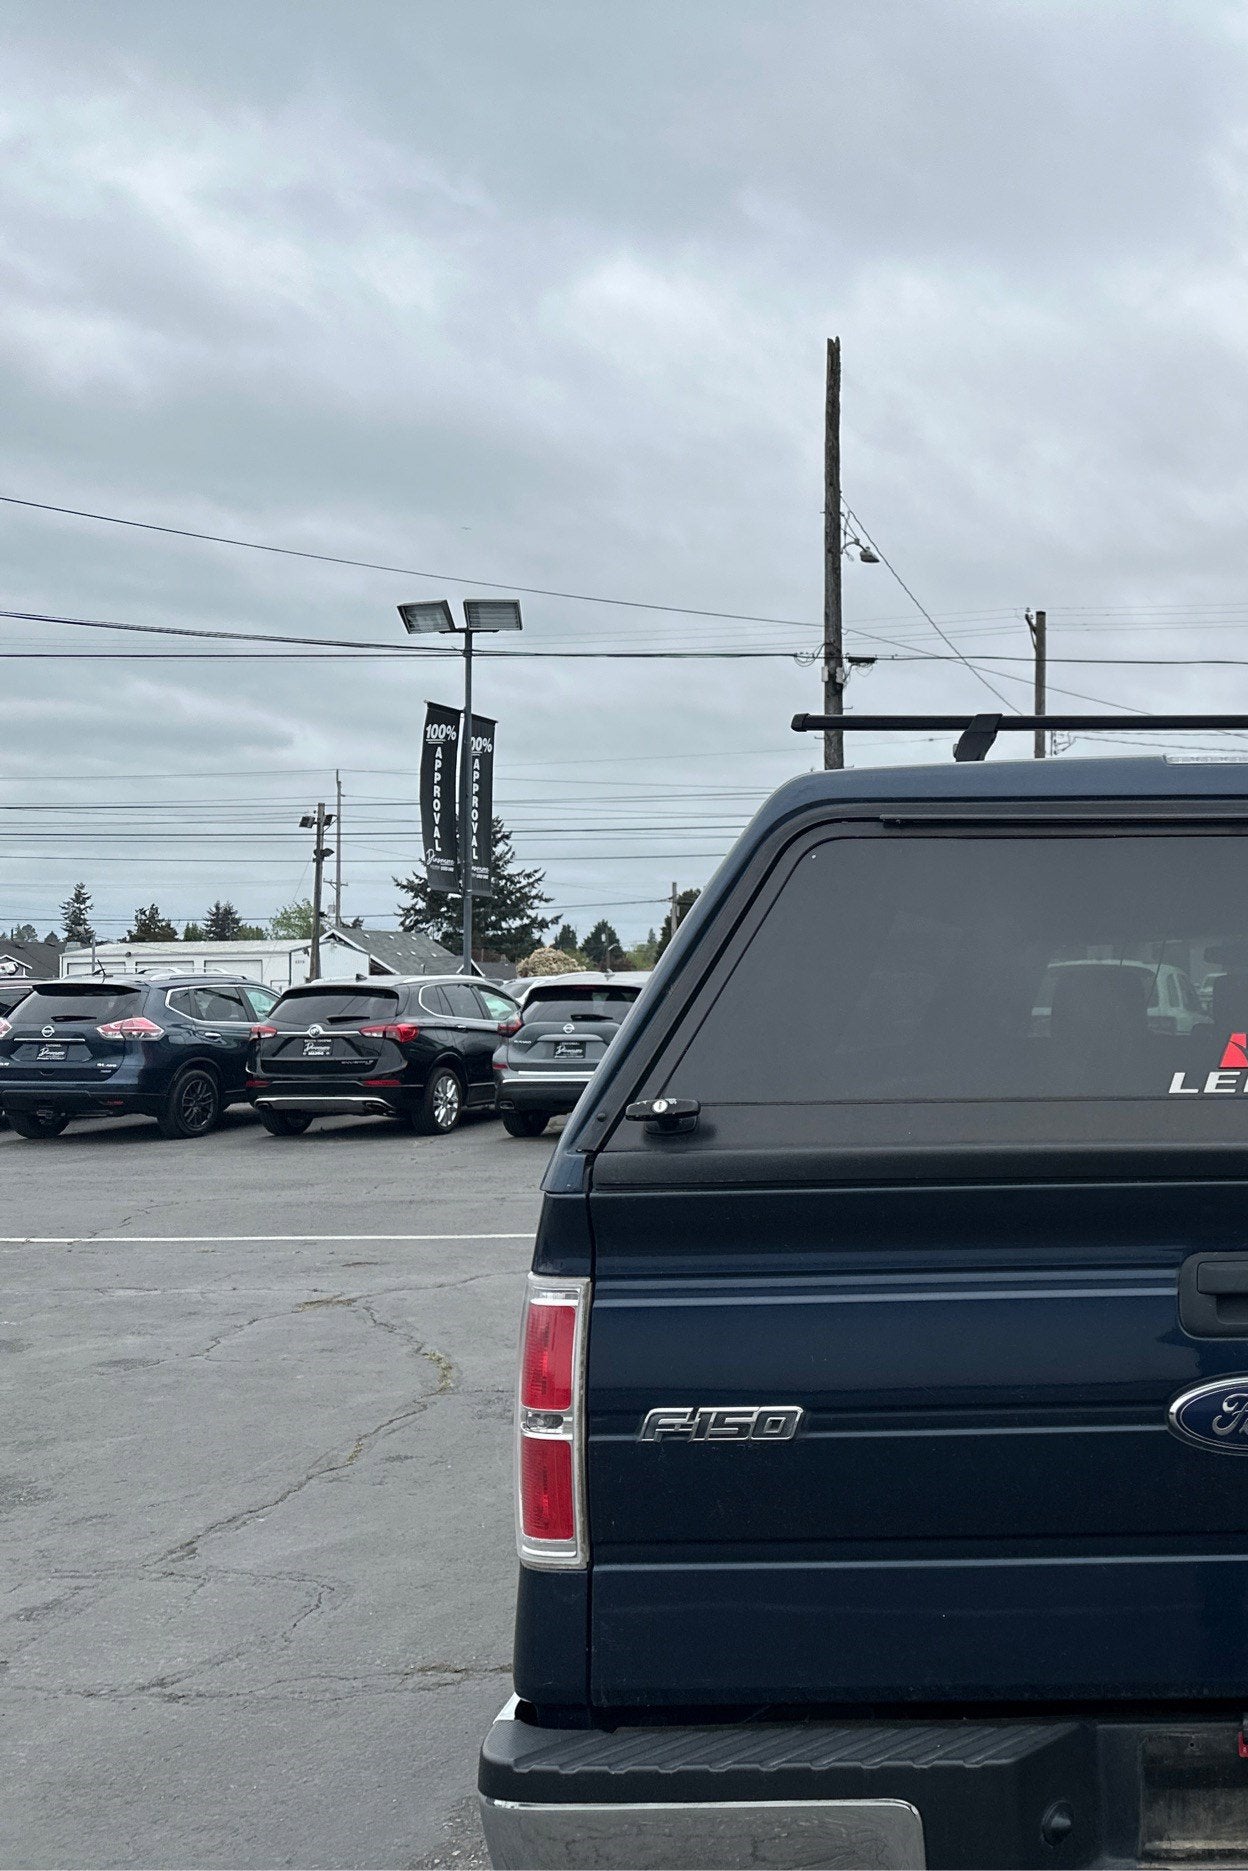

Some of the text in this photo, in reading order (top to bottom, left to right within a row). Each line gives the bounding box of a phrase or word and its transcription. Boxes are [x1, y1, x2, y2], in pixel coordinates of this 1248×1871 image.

[426, 723, 457, 741] 100%
[470, 736, 493, 753] 00%
[432, 746, 443, 852] APPROVAL
[471, 758, 481, 860] APPROVAL
[637, 1405, 804, 1443] F-150
